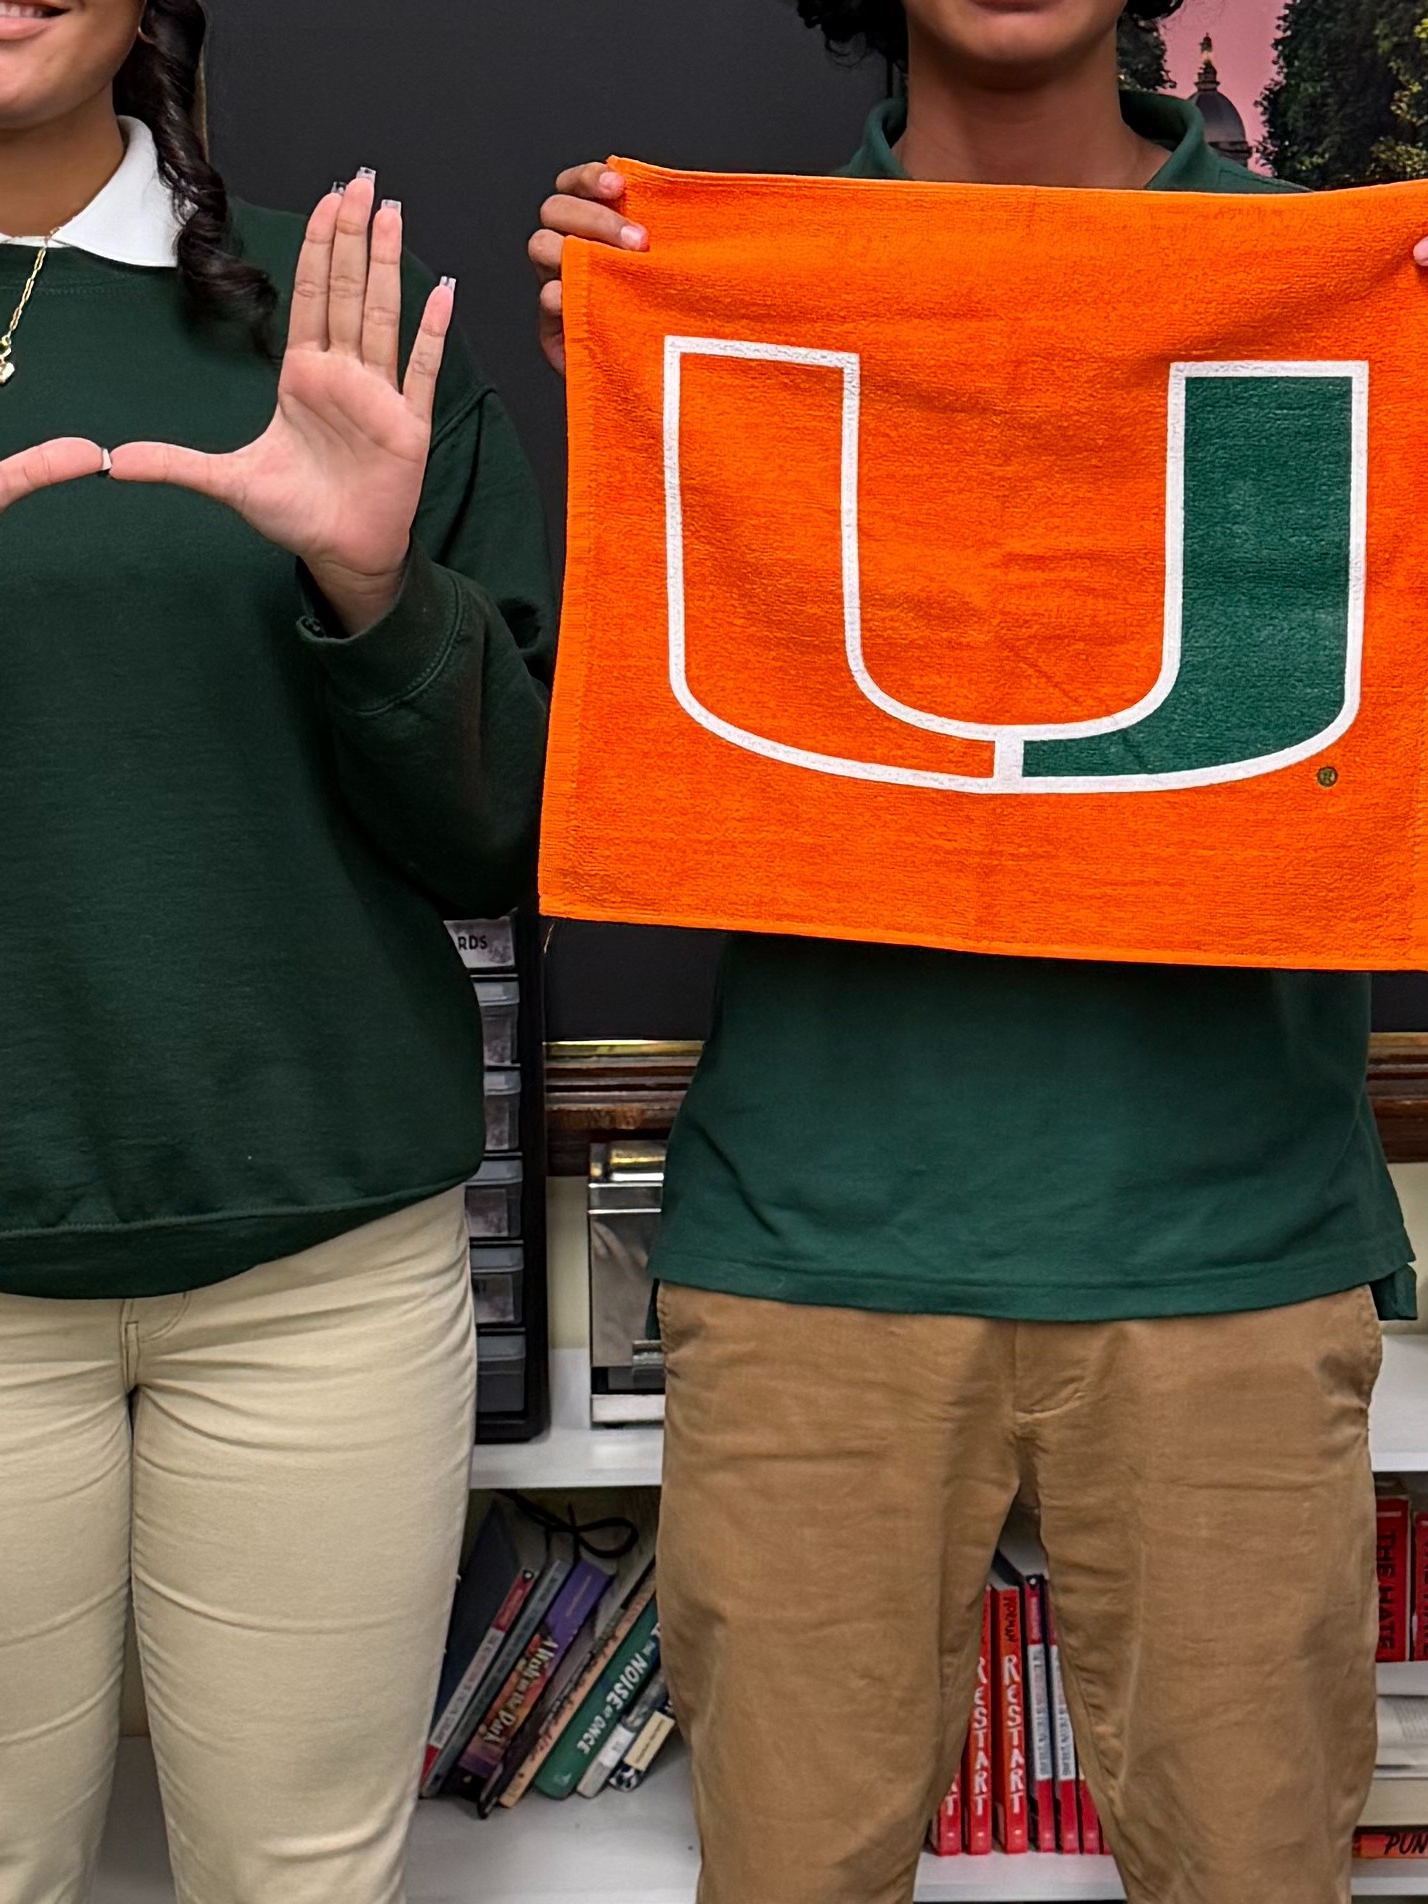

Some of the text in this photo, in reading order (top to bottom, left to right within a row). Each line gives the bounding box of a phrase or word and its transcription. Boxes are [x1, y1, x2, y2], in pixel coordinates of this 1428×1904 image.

[664, 335, 1369, 795] U
[576, 1714, 607, 1756] ONCE
[606, 1652, 650, 1711] NOISE
[1002, 1655, 1025, 1815] RESTART
